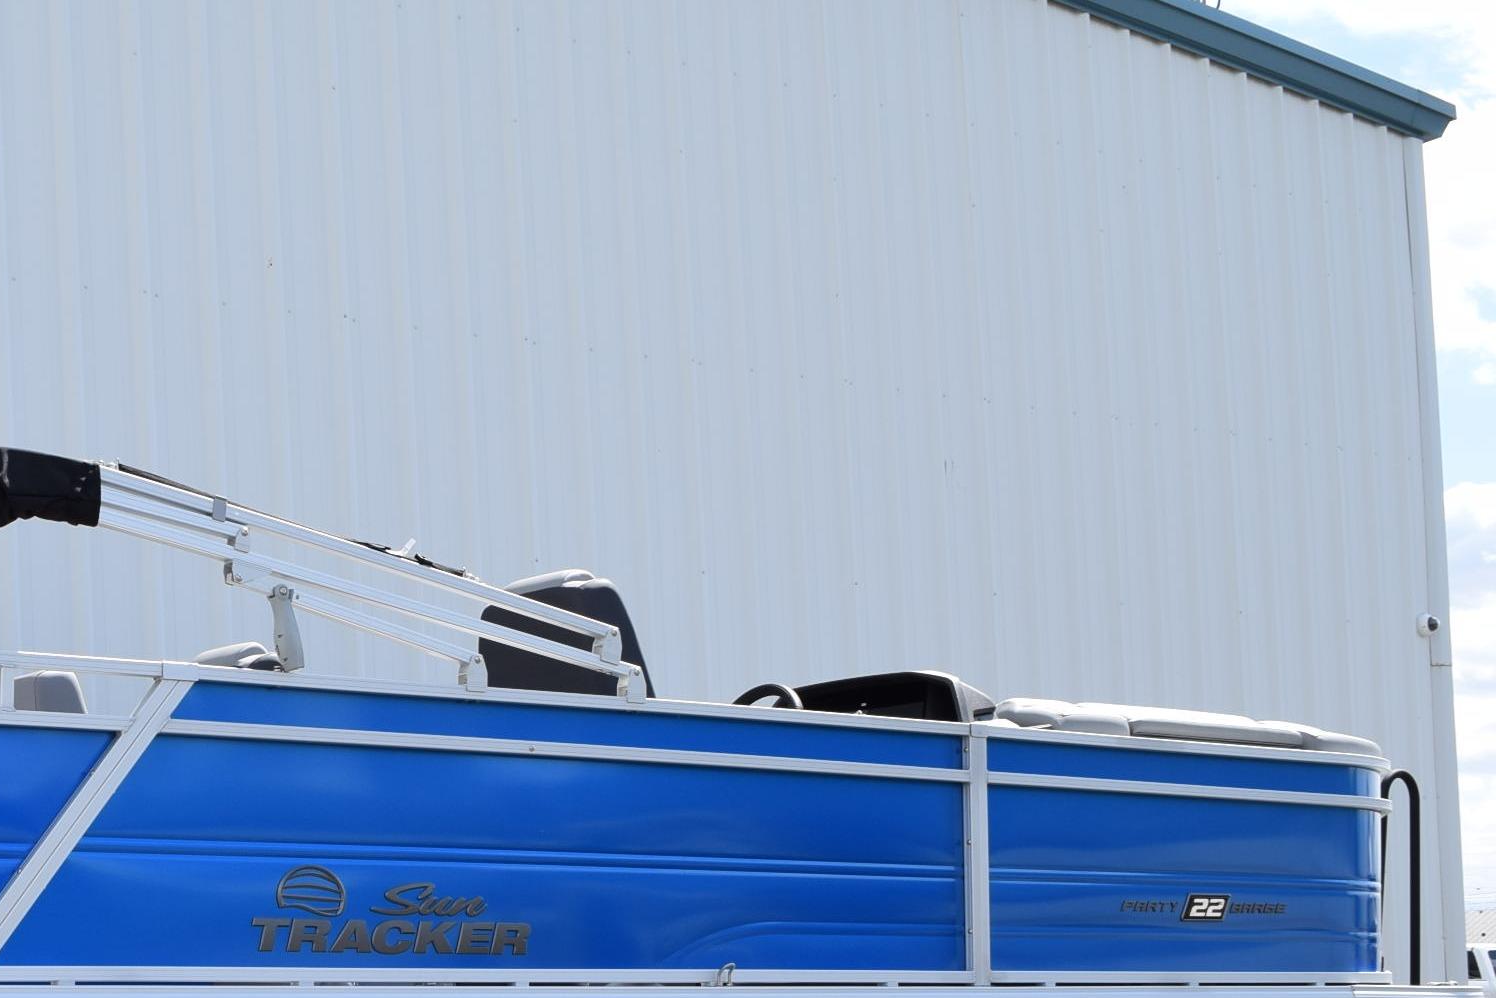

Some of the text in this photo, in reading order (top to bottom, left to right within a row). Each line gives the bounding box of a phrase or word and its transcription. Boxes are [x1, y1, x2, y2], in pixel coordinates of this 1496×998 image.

[369, 881, 488, 917] Sun
[1121, 901, 1177, 912] PARTY
[1190, 899, 1225, 917] 22
[251, 916, 532, 956] TRACKER
